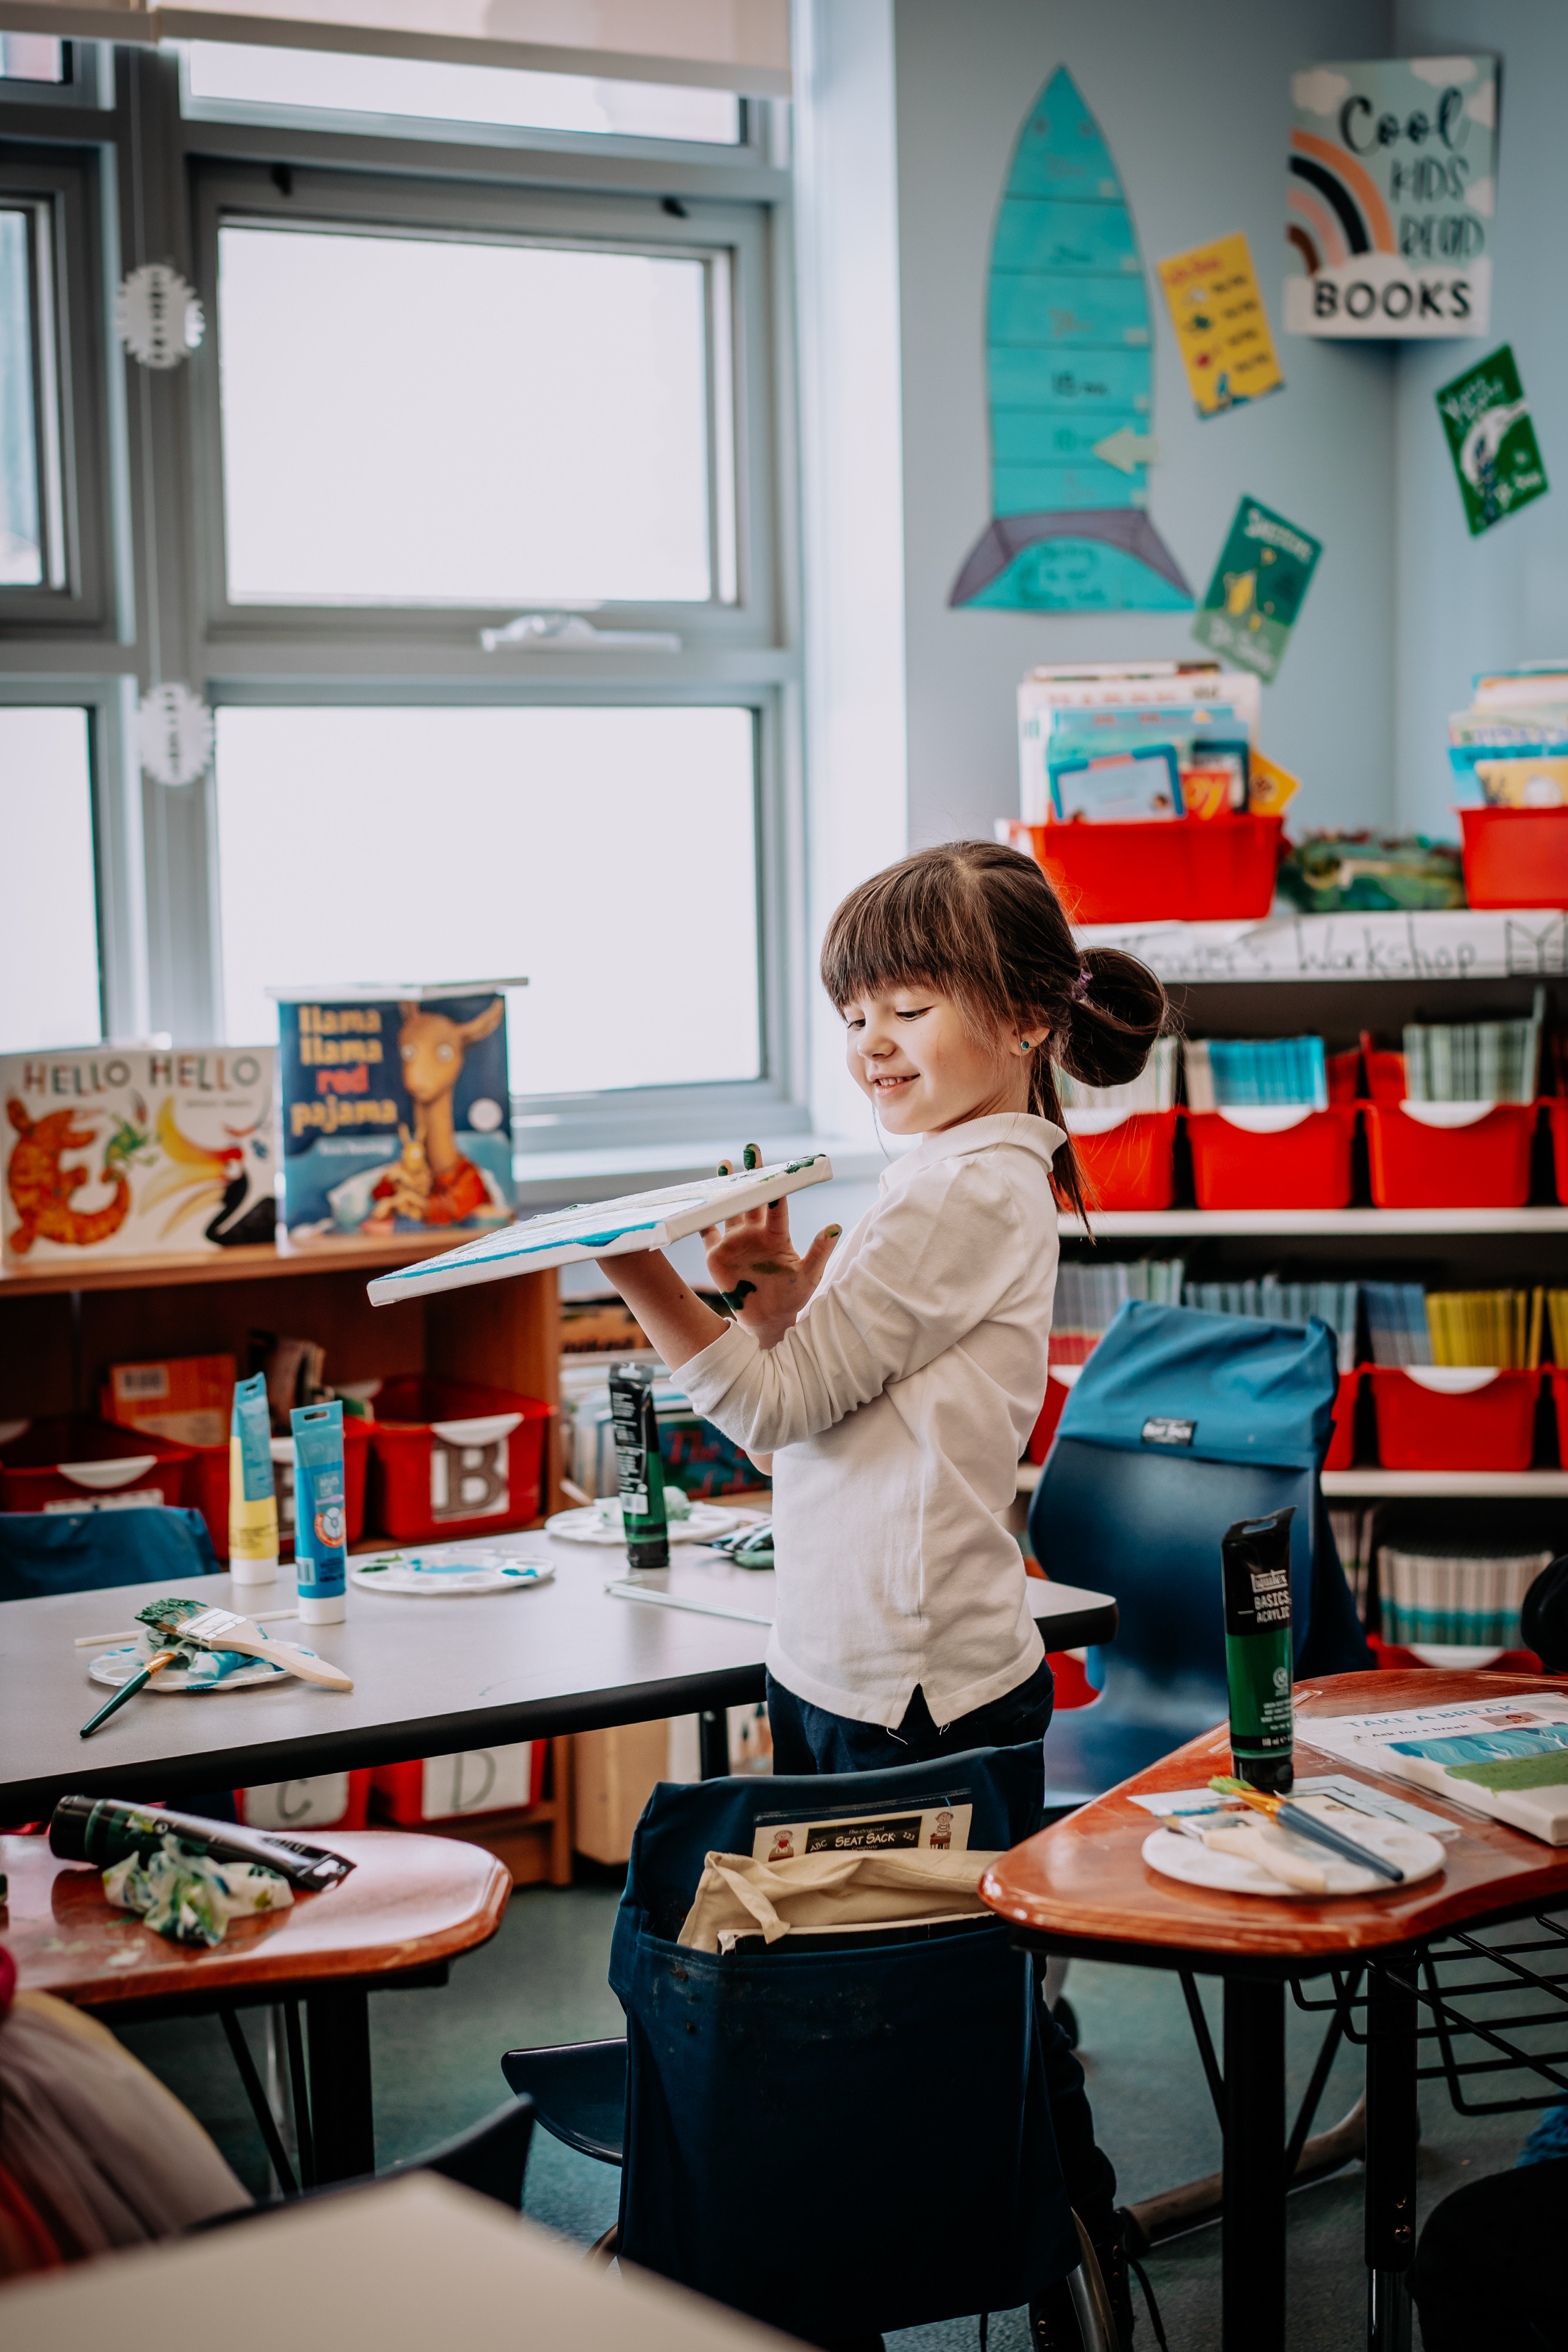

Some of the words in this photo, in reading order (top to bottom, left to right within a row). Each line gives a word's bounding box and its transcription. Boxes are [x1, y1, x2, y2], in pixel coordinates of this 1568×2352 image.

[1339, 86, 1471, 157] Cool
[1390, 154, 1470, 205] KIDS
[1399, 213, 1485, 260] READ
[1314, 280, 1471, 320] BOOKS
[298, 1005, 382, 1035] llama
[300, 1036, 383, 1065] llama
[23, 1059, 131, 1096] HELLO
[149, 1055, 261, 1091] HELLO
[316, 1063, 369, 1095] red
[290, 1094, 398, 1137] pajama
[432, 1437, 508, 1522] B
[1254, 1590, 1289, 1610] BASICS
[1257, 1606, 1290, 1623] ACRYLIC
[1343, 1717, 1411, 1727] TAKE
[1436, 1705, 1520, 1719] BREAK
[449, 1749, 496, 1812] D
[276, 1778, 312, 1821] C
[810, 1839, 827, 1852] ABC
[835, 1835, 864, 1847] SEAT
[866, 1833, 895, 1845] SACK
[902, 1831, 915, 1841] 123
